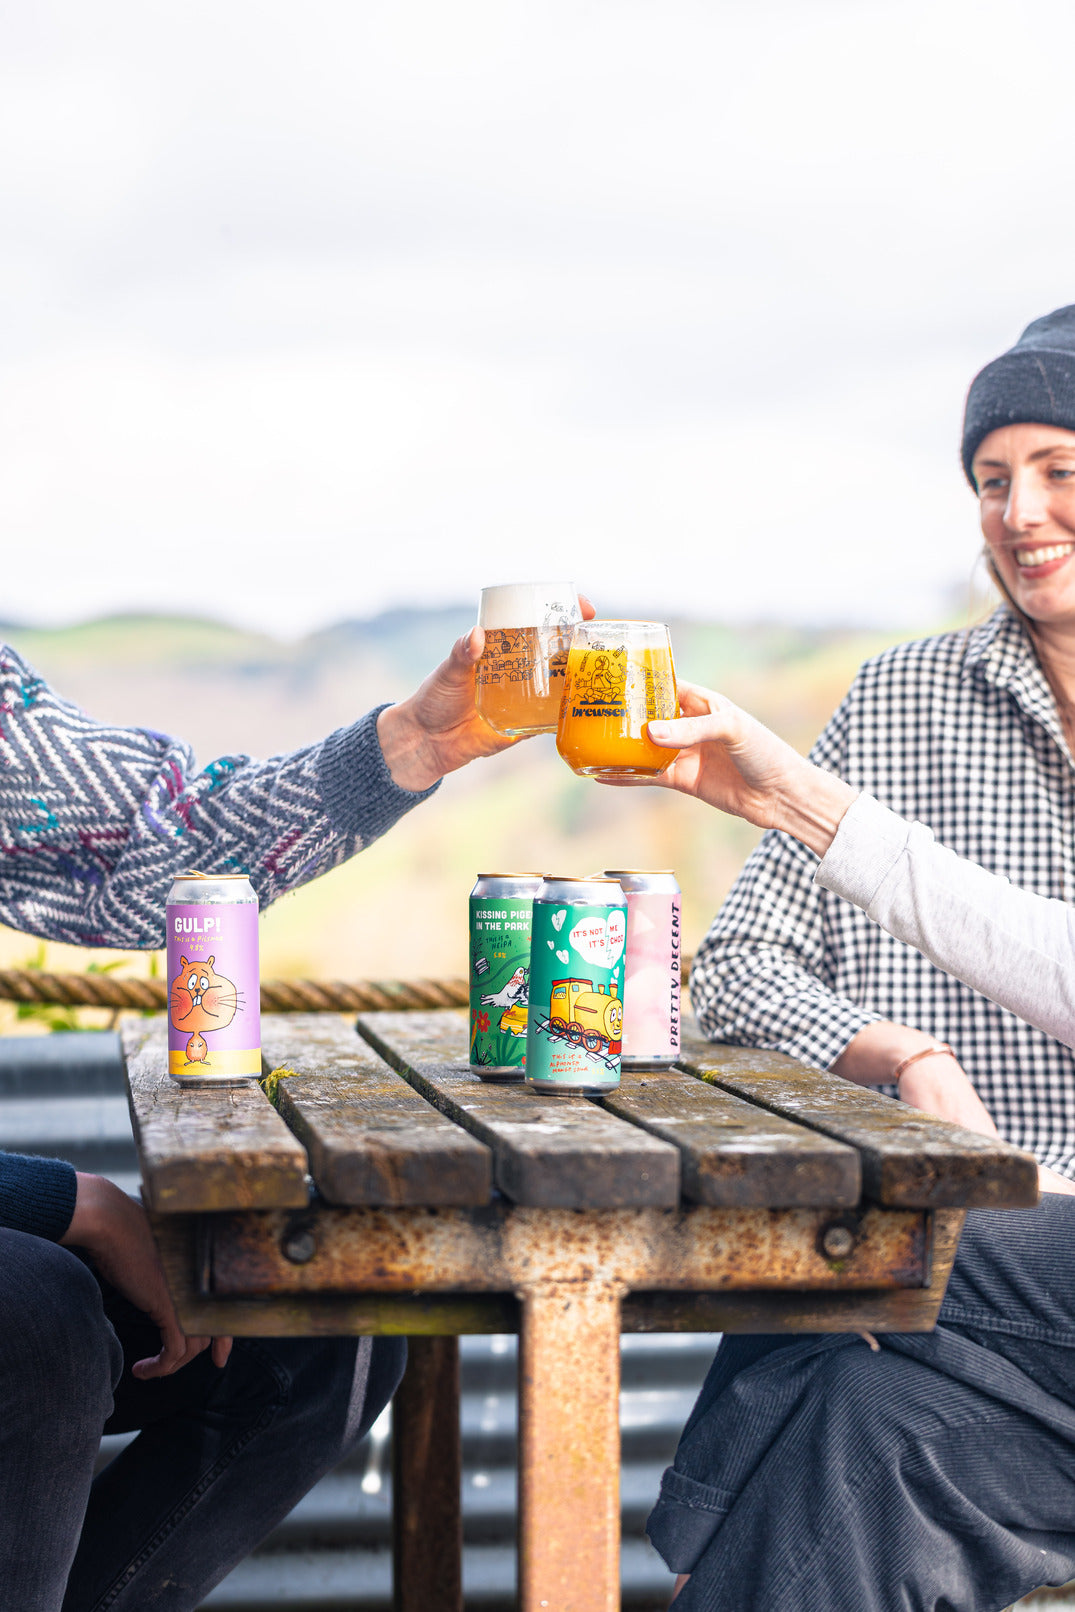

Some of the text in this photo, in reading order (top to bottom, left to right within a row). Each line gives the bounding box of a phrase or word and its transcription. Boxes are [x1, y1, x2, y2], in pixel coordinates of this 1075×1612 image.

[476, 910, 533, 920] KISSING PIGE
[174, 917, 221, 933] GULP!
[476, 921, 530, 931] IN THE PARK
[573, 924, 618, 938] IT'S NOT ME
[589, 939, 605, 948] IT'S
[670, 902, 679, 1046] PRETTY DECENT
